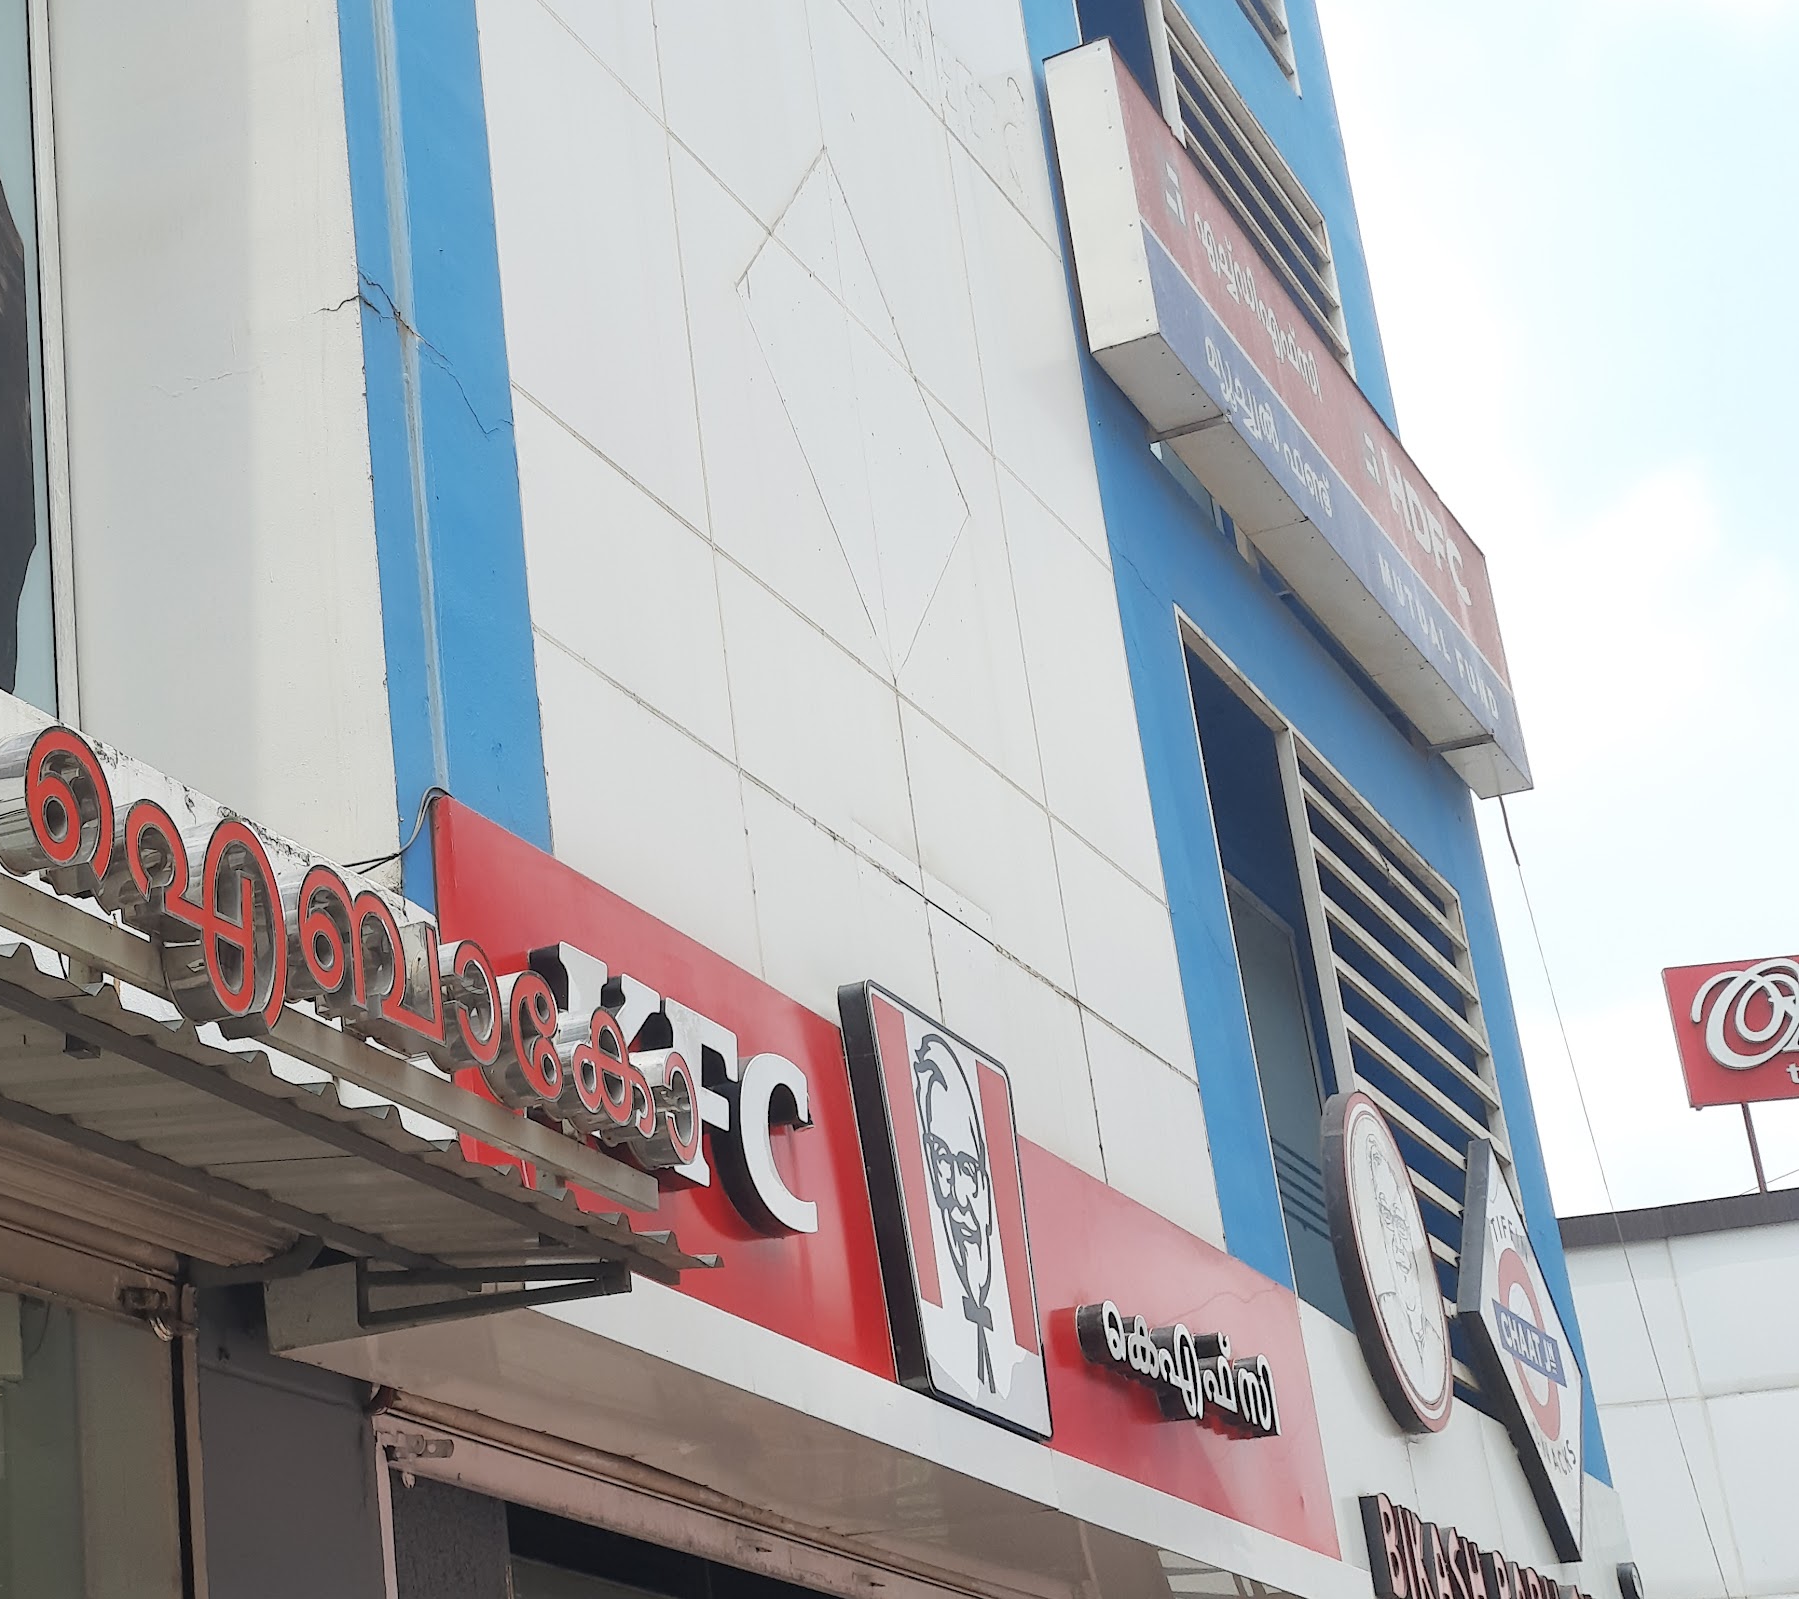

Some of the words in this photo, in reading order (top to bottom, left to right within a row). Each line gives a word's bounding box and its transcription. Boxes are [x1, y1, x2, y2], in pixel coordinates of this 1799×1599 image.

[1380, 446, 1472, 606] HDFC
[1378, 552, 1452, 665] MUTUAL
[1454, 647, 1500, 721] FUND
[1501, 1311, 1542, 1367] CHAAT
